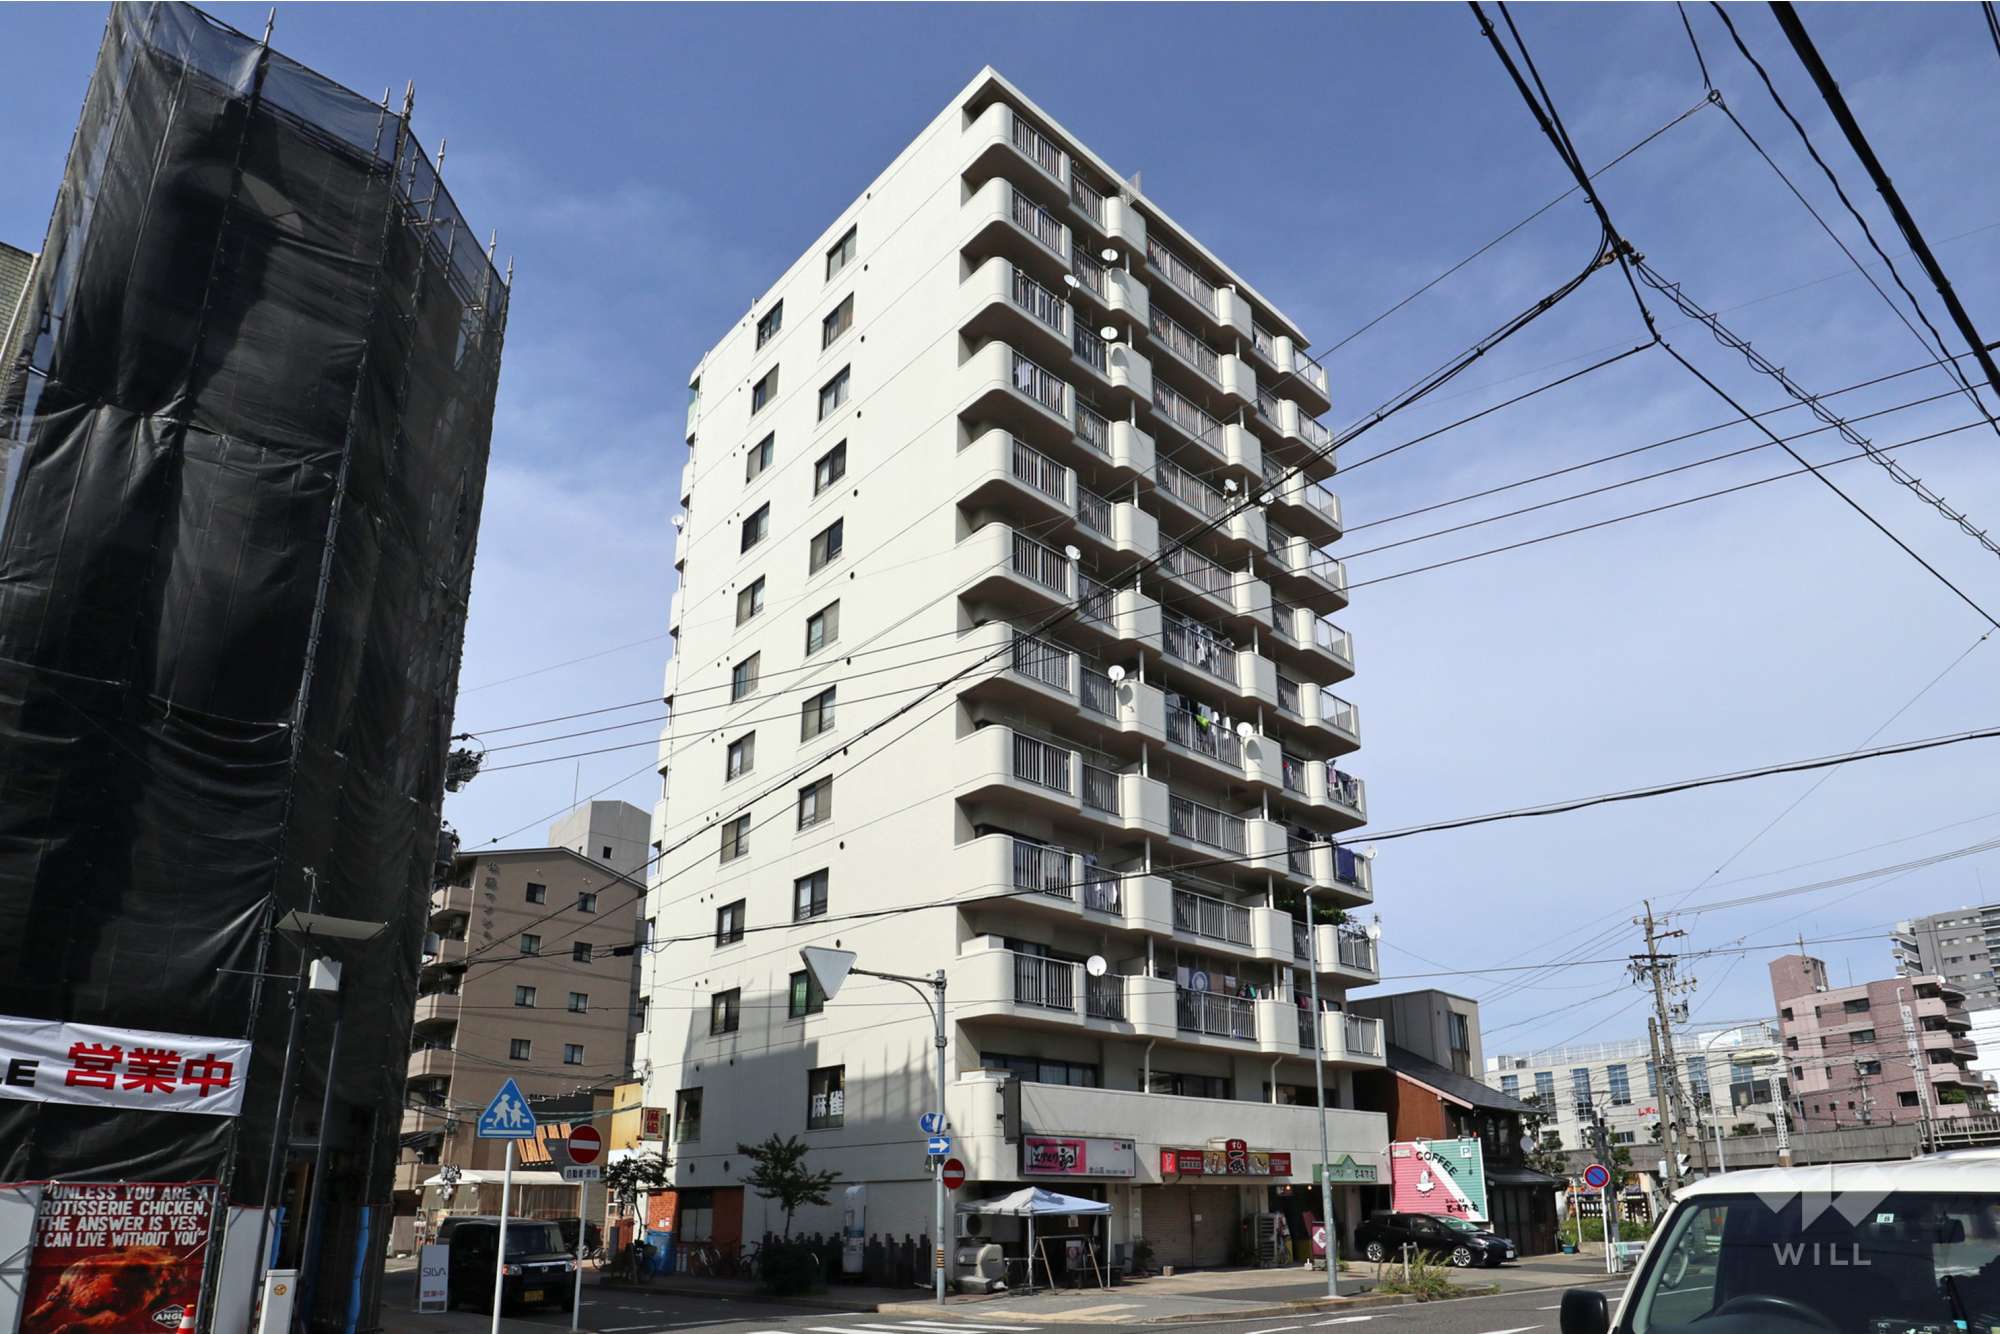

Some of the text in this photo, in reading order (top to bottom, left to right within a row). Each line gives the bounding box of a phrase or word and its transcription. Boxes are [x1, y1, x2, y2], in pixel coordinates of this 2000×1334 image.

[0, 1041, 233, 1097] E 営業中
[1416, 1151, 1458, 1177] COFFEE
[126, 1186, 154, 1200] YOU
[161, 1187, 191, 1200] ARE
[40, 1201, 208, 1217] ROTISSERIE CHICKEN,
[39, 1216, 70, 1231] THE
[76, 1217, 143, 1231] ANSWER
[150, 1217, 163, 1231] IS
[44, 1232, 73, 1247] CAN
[77, 1232, 106, 1247] LIVE
[112, 1231, 168, 1247] WITHOUT
[155, 1313, 184, 1321] ANGL
